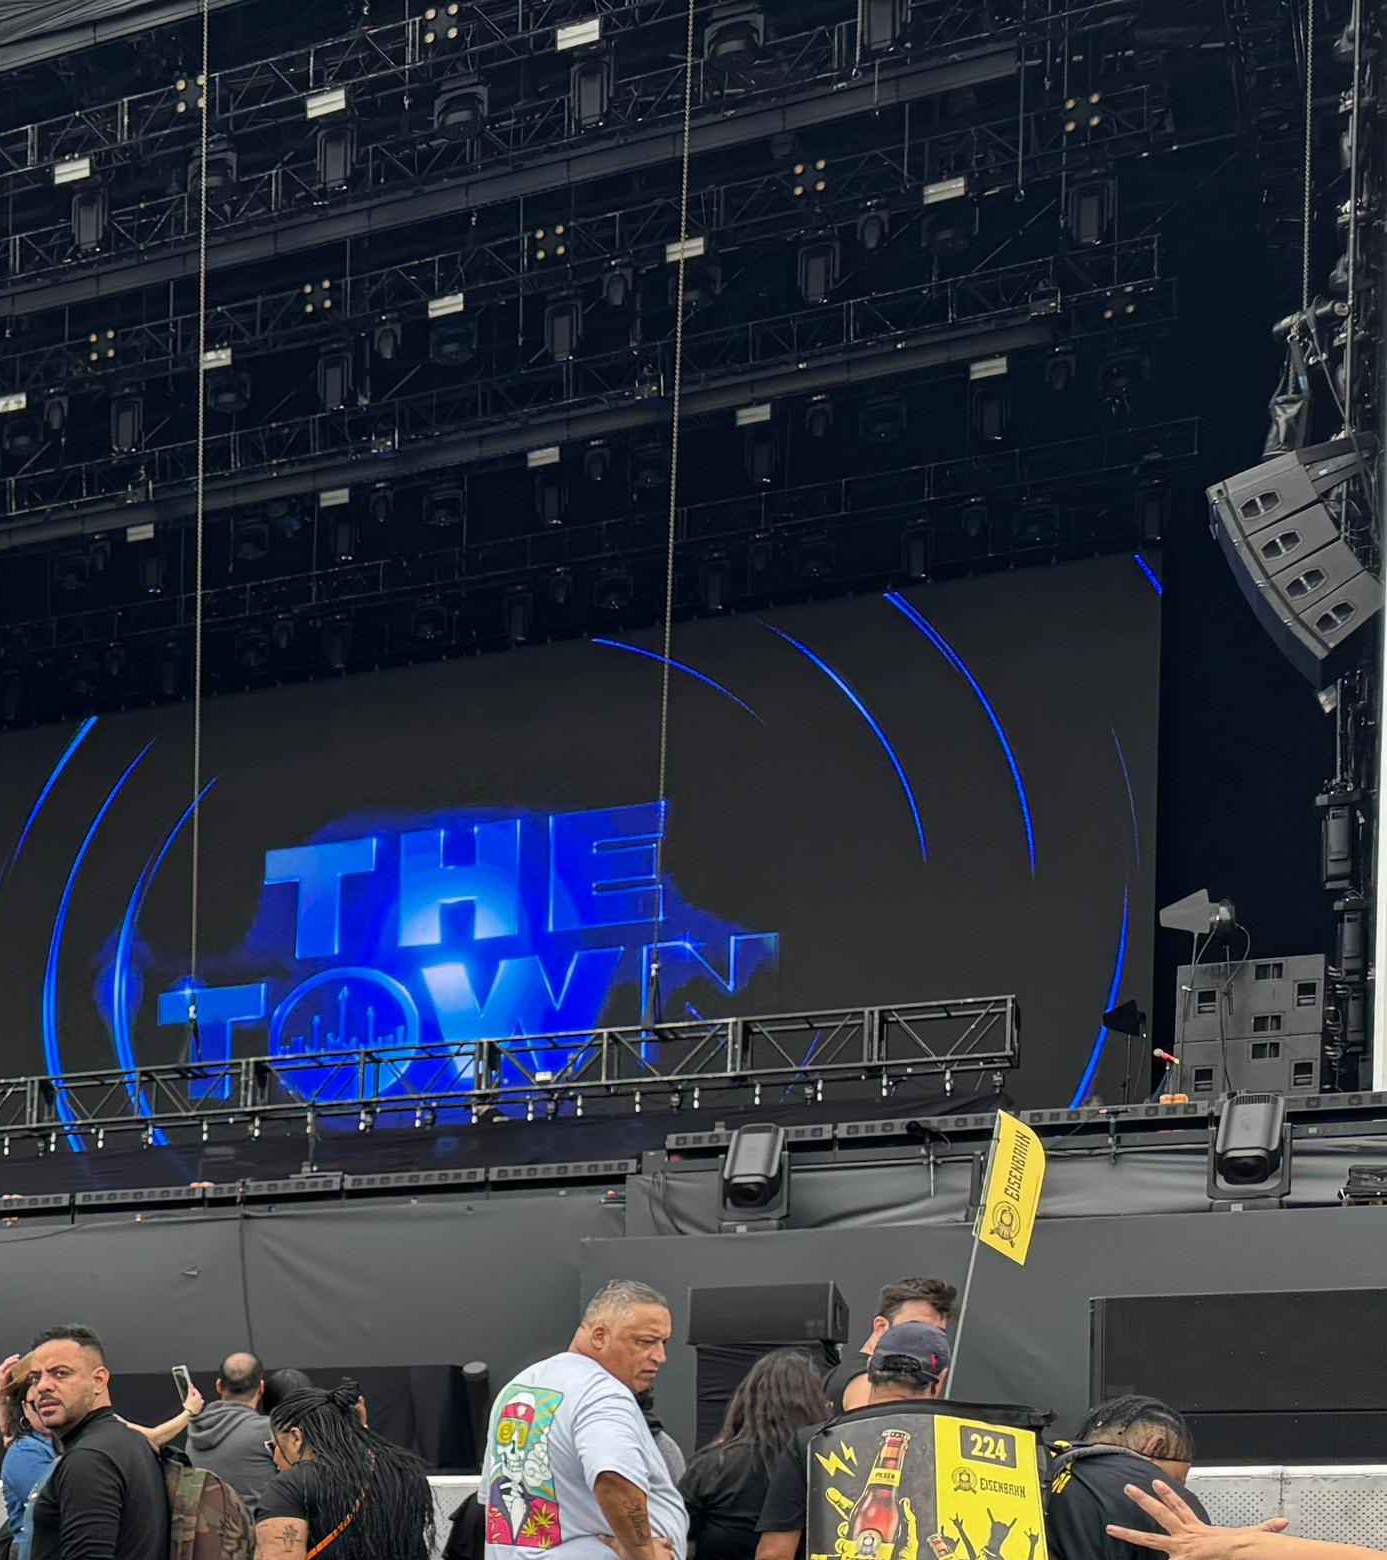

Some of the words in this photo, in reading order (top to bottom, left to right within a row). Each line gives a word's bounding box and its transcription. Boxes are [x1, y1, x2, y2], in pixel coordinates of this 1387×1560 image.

[264, 800, 670, 959] THE
[158, 932, 779, 1101] TOWN
[1003, 1130, 1031, 1202] EISENBAHN
[970, 1432, 1007, 1461] 224
[979, 1477, 1026, 1499] EISENBAHN
